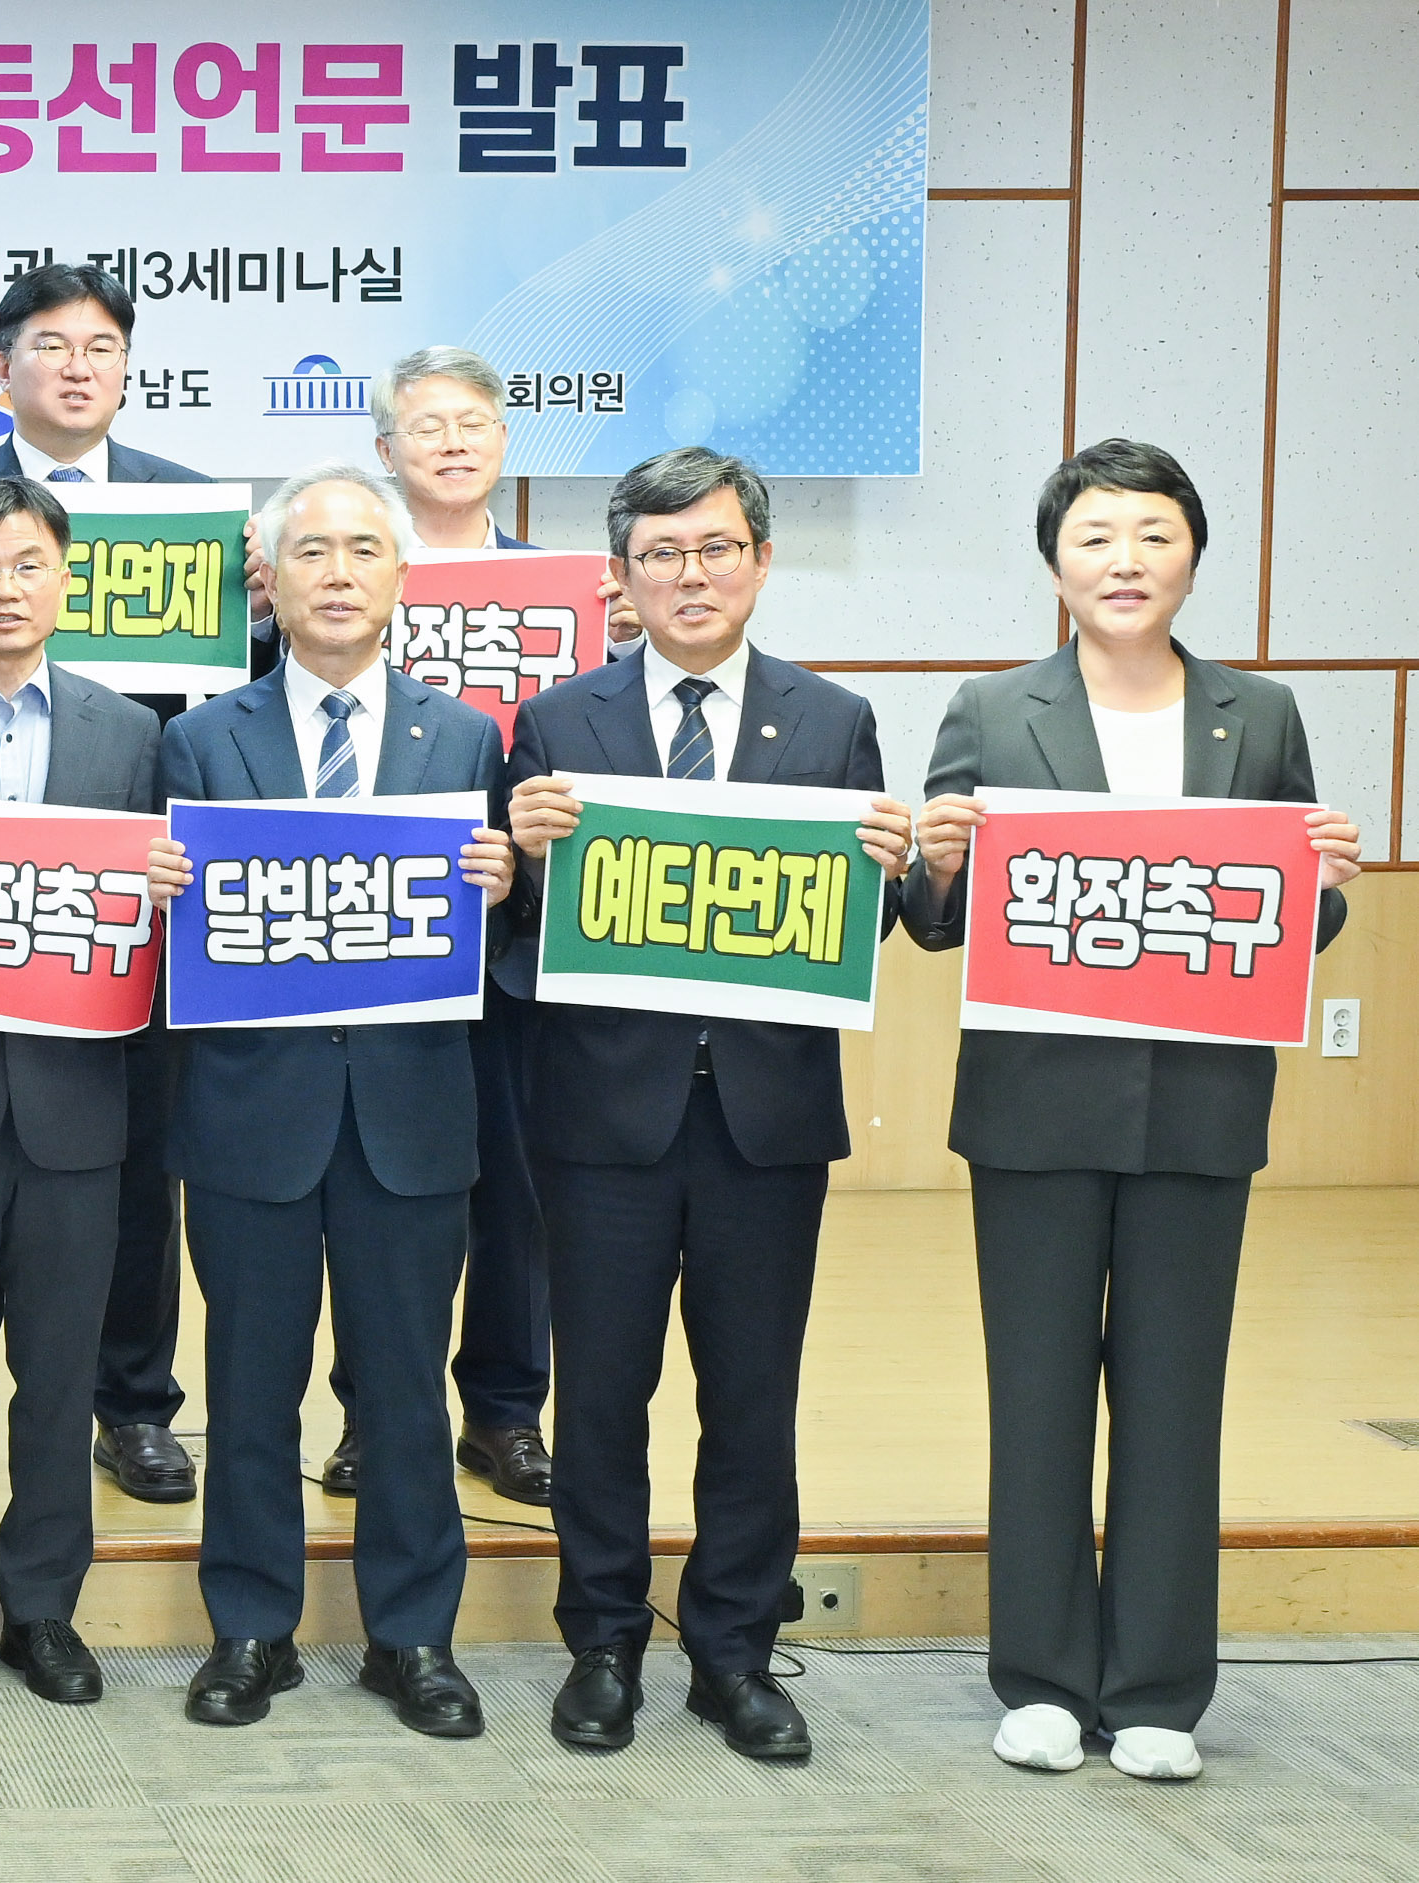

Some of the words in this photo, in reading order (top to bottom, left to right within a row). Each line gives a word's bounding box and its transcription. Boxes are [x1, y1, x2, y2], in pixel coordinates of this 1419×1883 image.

[453, 42, 688, 173] 발표
[118, 369, 212, 410] 남도
[504, 371, 626, 413] 회의원
[49, 538, 224, 639] 타면제
[202, 854, 455, 964] 달빛철도
[579, 835, 851, 965] 예타면제
[1004, 848, 1284, 978] 확정촉구
